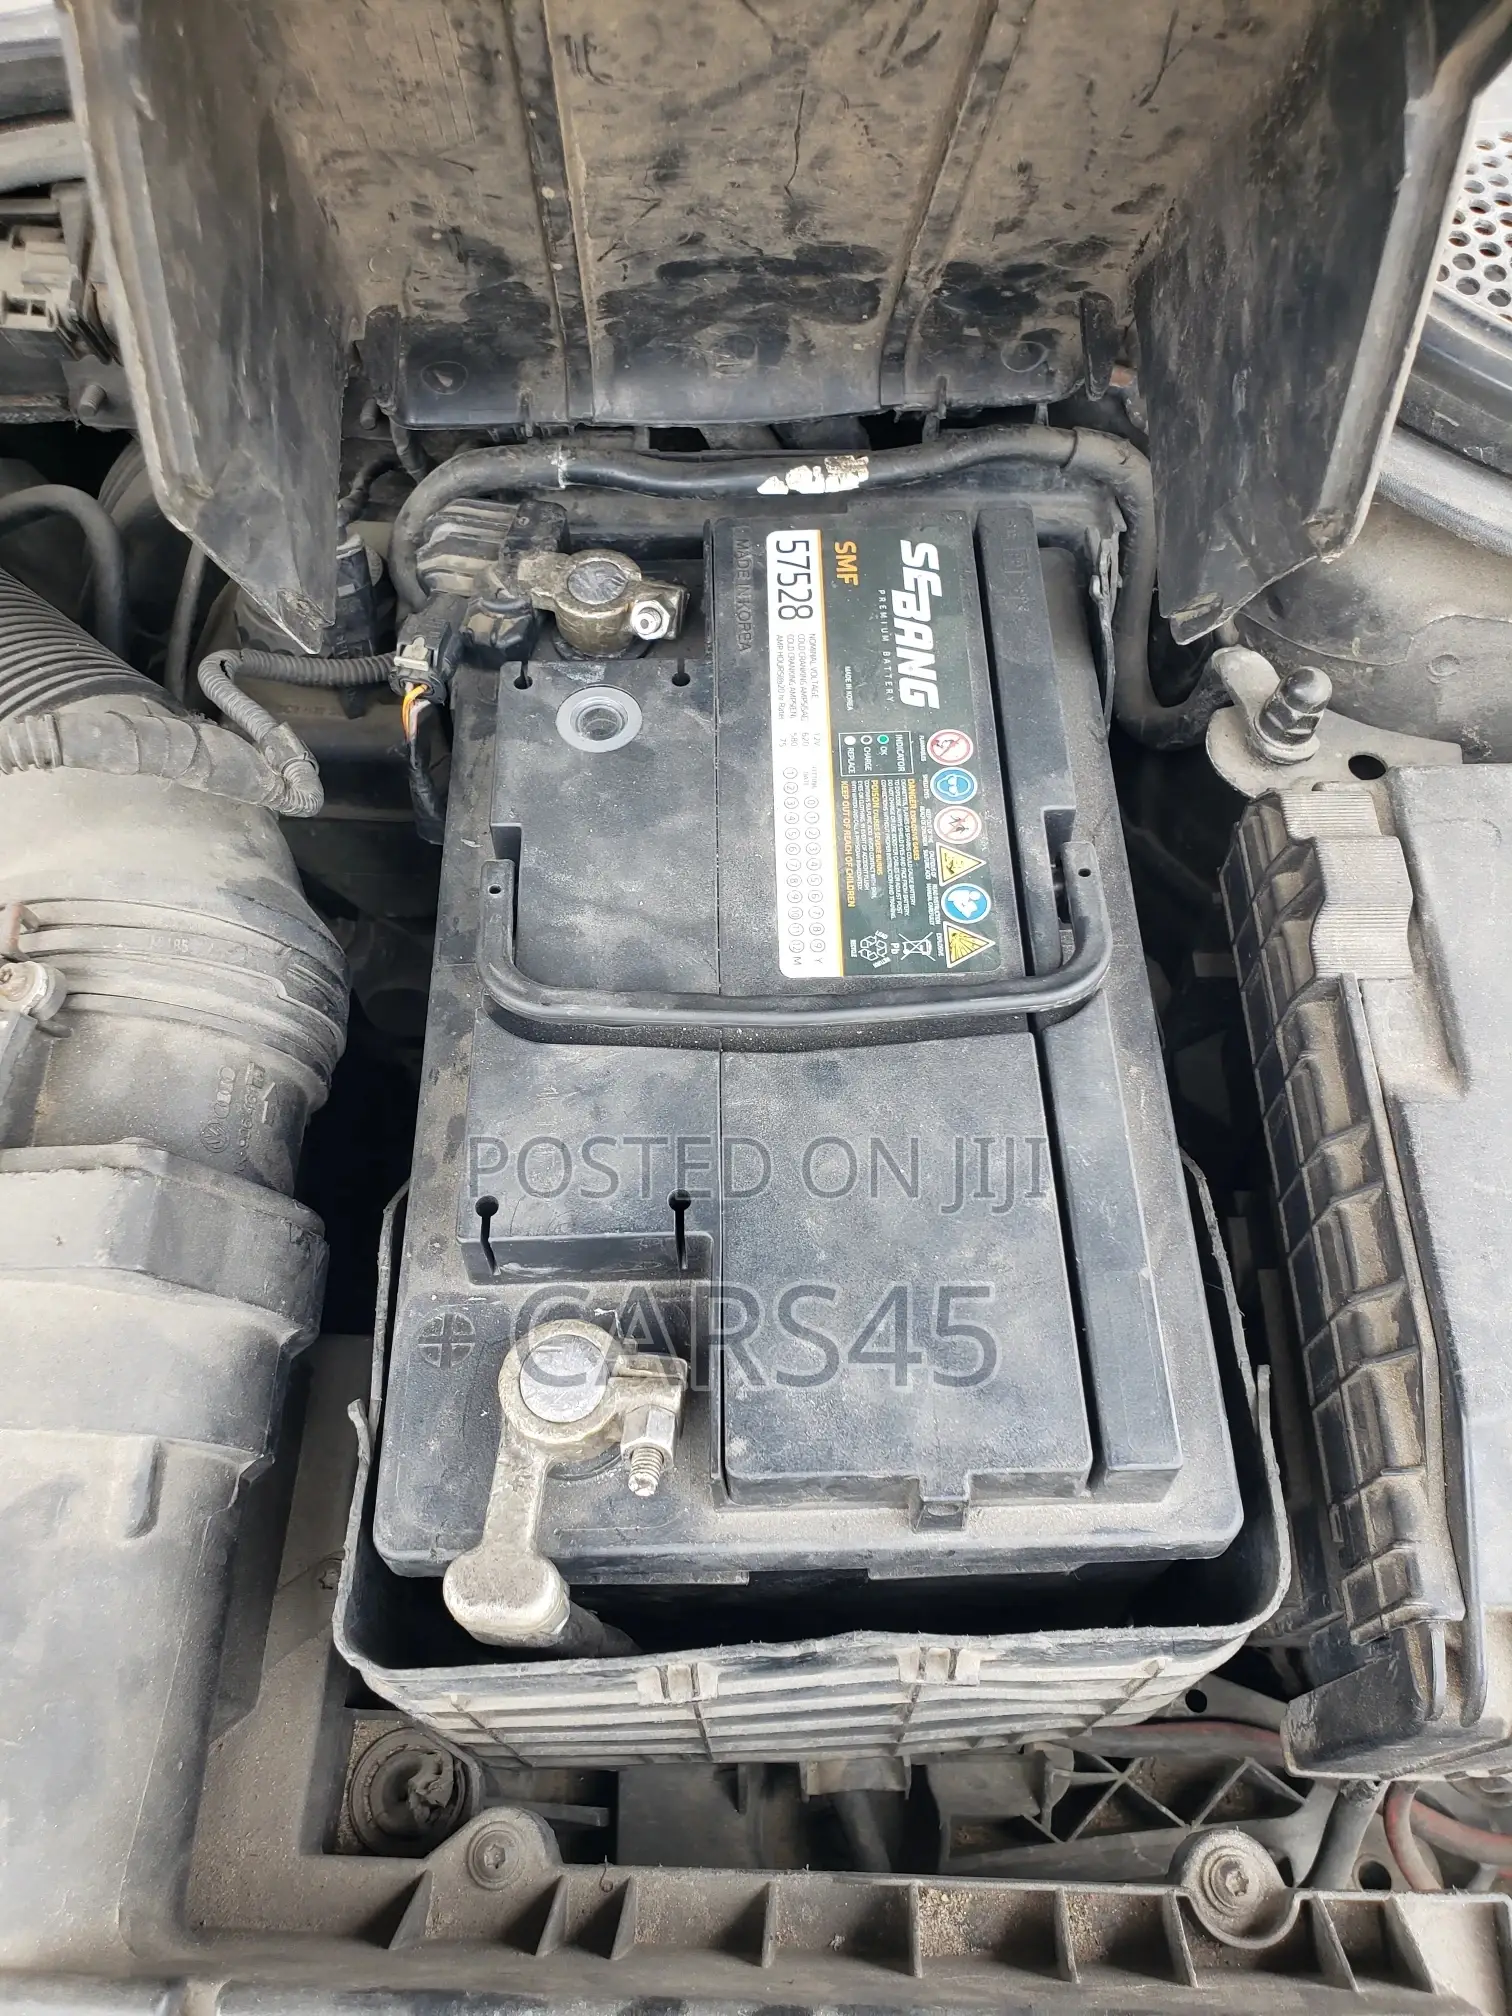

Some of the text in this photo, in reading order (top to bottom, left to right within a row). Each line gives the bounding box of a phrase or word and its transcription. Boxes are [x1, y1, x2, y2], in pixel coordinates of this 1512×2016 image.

[834, 541, 858, 586] SMF
[776, 540, 813, 621] 57528
[736, 539, 752, 651] MADE IN KOREA
[891, 540, 942, 709] SEBANG
[878, 590, 894, 702] PREMIUM BATTERY
[788, 652, 796, 685] CRANKING
[798, 652, 807, 685] CRANKING
[844, 666, 852, 682] MADE
[810, 667, 819, 698] VOLTAGE
[846, 691, 854, 711] KOREA
[779, 738, 786, 747] 75
[790, 733, 798, 746] 580
[880, 746, 887, 755] OK
[864, 747, 872, 771] CHARGE
[896, 734, 905, 772] INDICATOR
[871, 780, 879, 808] POISON
[842, 801, 850, 817] OUT
[908, 779, 920, 860] DANGER EXPLOSIVE GASES
[843, 818, 850, 829] OF
[844, 830, 852, 854] REACH
[845, 856, 852, 867] OF
[846, 868, 855, 908] CHILDREN
[793, 957, 802, 965] M
[891, 943, 900, 954] Pb
